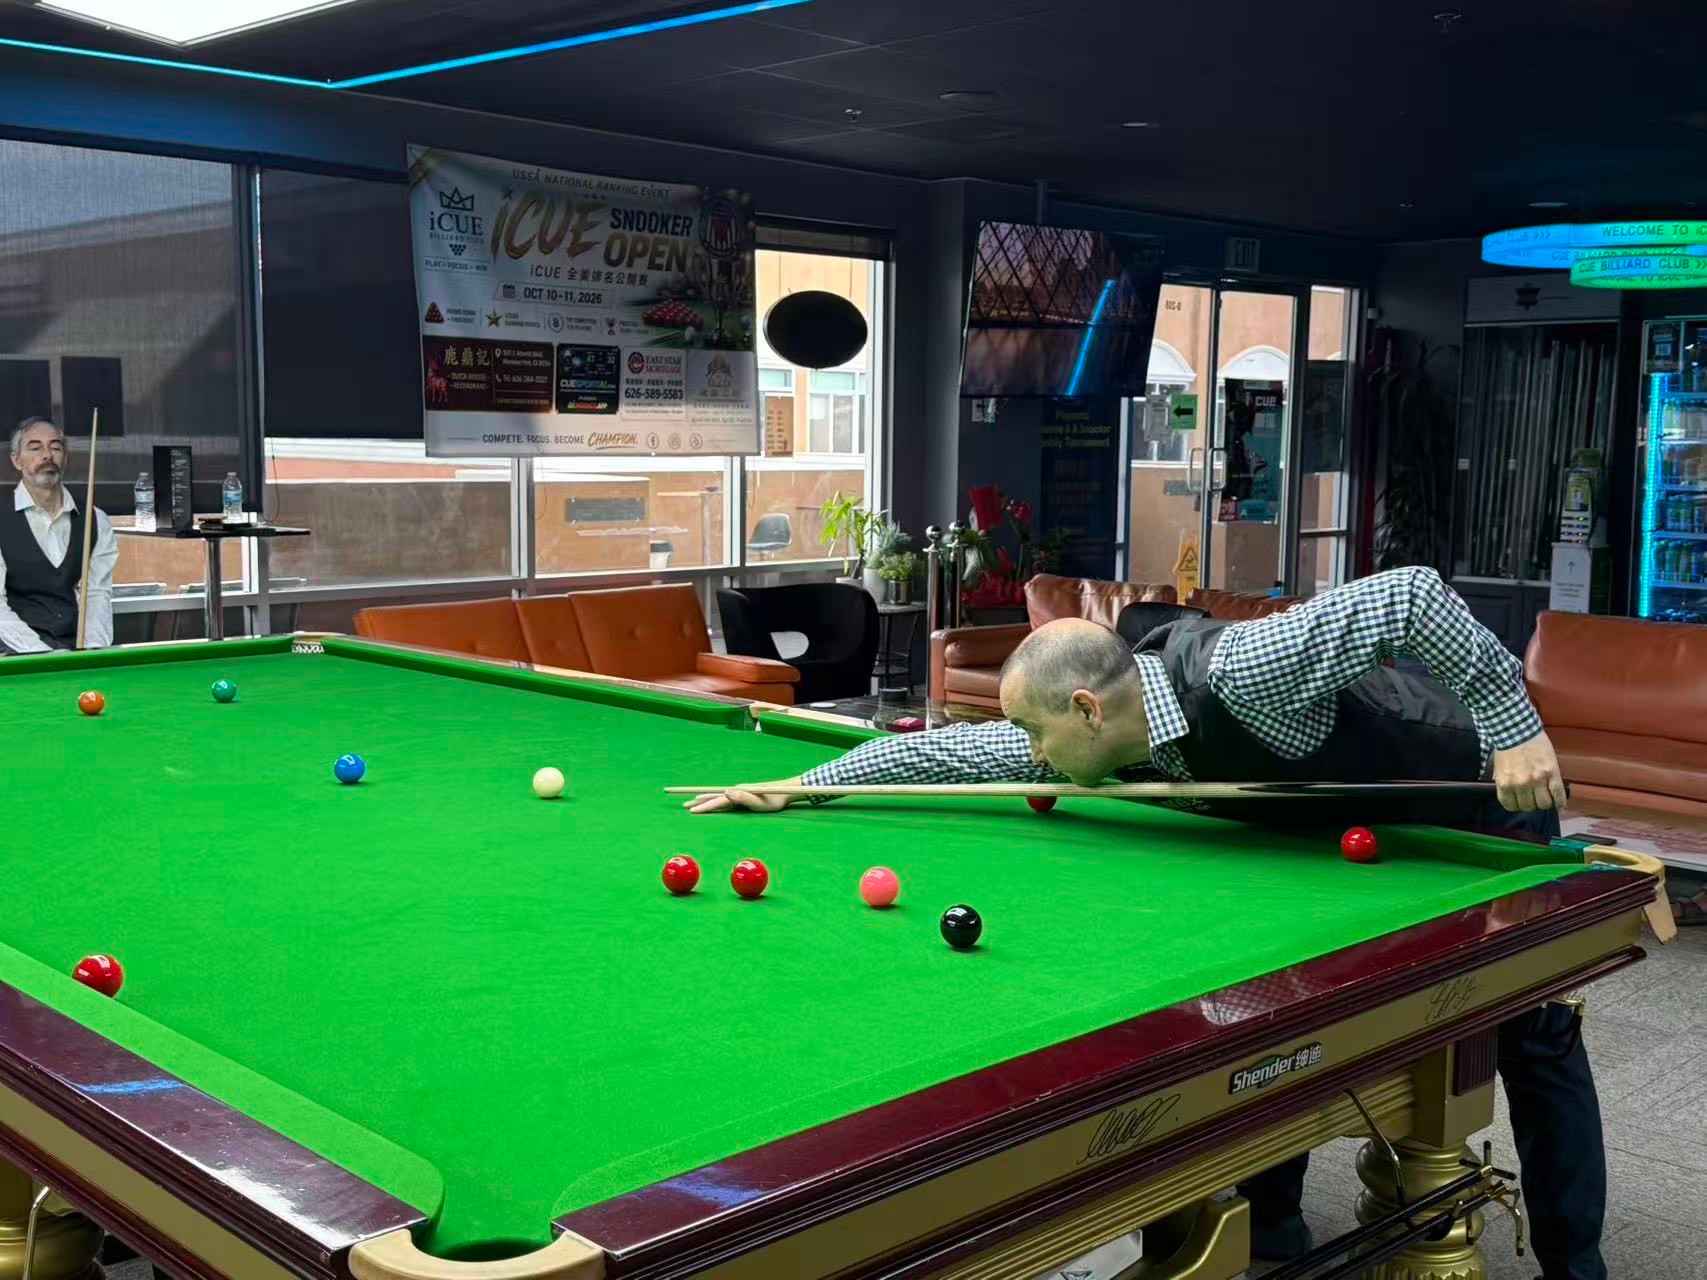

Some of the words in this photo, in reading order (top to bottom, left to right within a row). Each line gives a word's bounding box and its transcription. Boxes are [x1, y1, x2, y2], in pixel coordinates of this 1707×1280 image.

[512, 169, 541, 182] USSA
[543, 173, 593, 189] NATIONAL
[596, 180, 639, 195] RANKING
[640, 186, 670, 199] EVENT
[429, 211, 484, 236] iCUE
[490, 188, 608, 264] iCUE
[610, 207, 693, 237] SNOOKER
[1601, 224, 1664, 237] WELCOME
[1672, 224, 1688, 235] TO
[603, 232, 689, 273] OPEN
[529, 264, 561, 278] iCUE
[1579, 261, 1596, 273] CUE
[1601, 259, 1651, 271] BILLIARD
[1659, 258, 1689, 269] CLUB
[523, 288, 544, 299] OCT
[547, 289, 576, 304] 10-11,
[578, 292, 603, 304] 2026
[552, 317, 560, 328] 8
[444, 344, 490, 368] 鹿鼎記
[624, 388, 684, 400] 626-589-5583
[554, 435, 584, 444] BECOME
[1232, 1056, 1295, 1093] Shender
